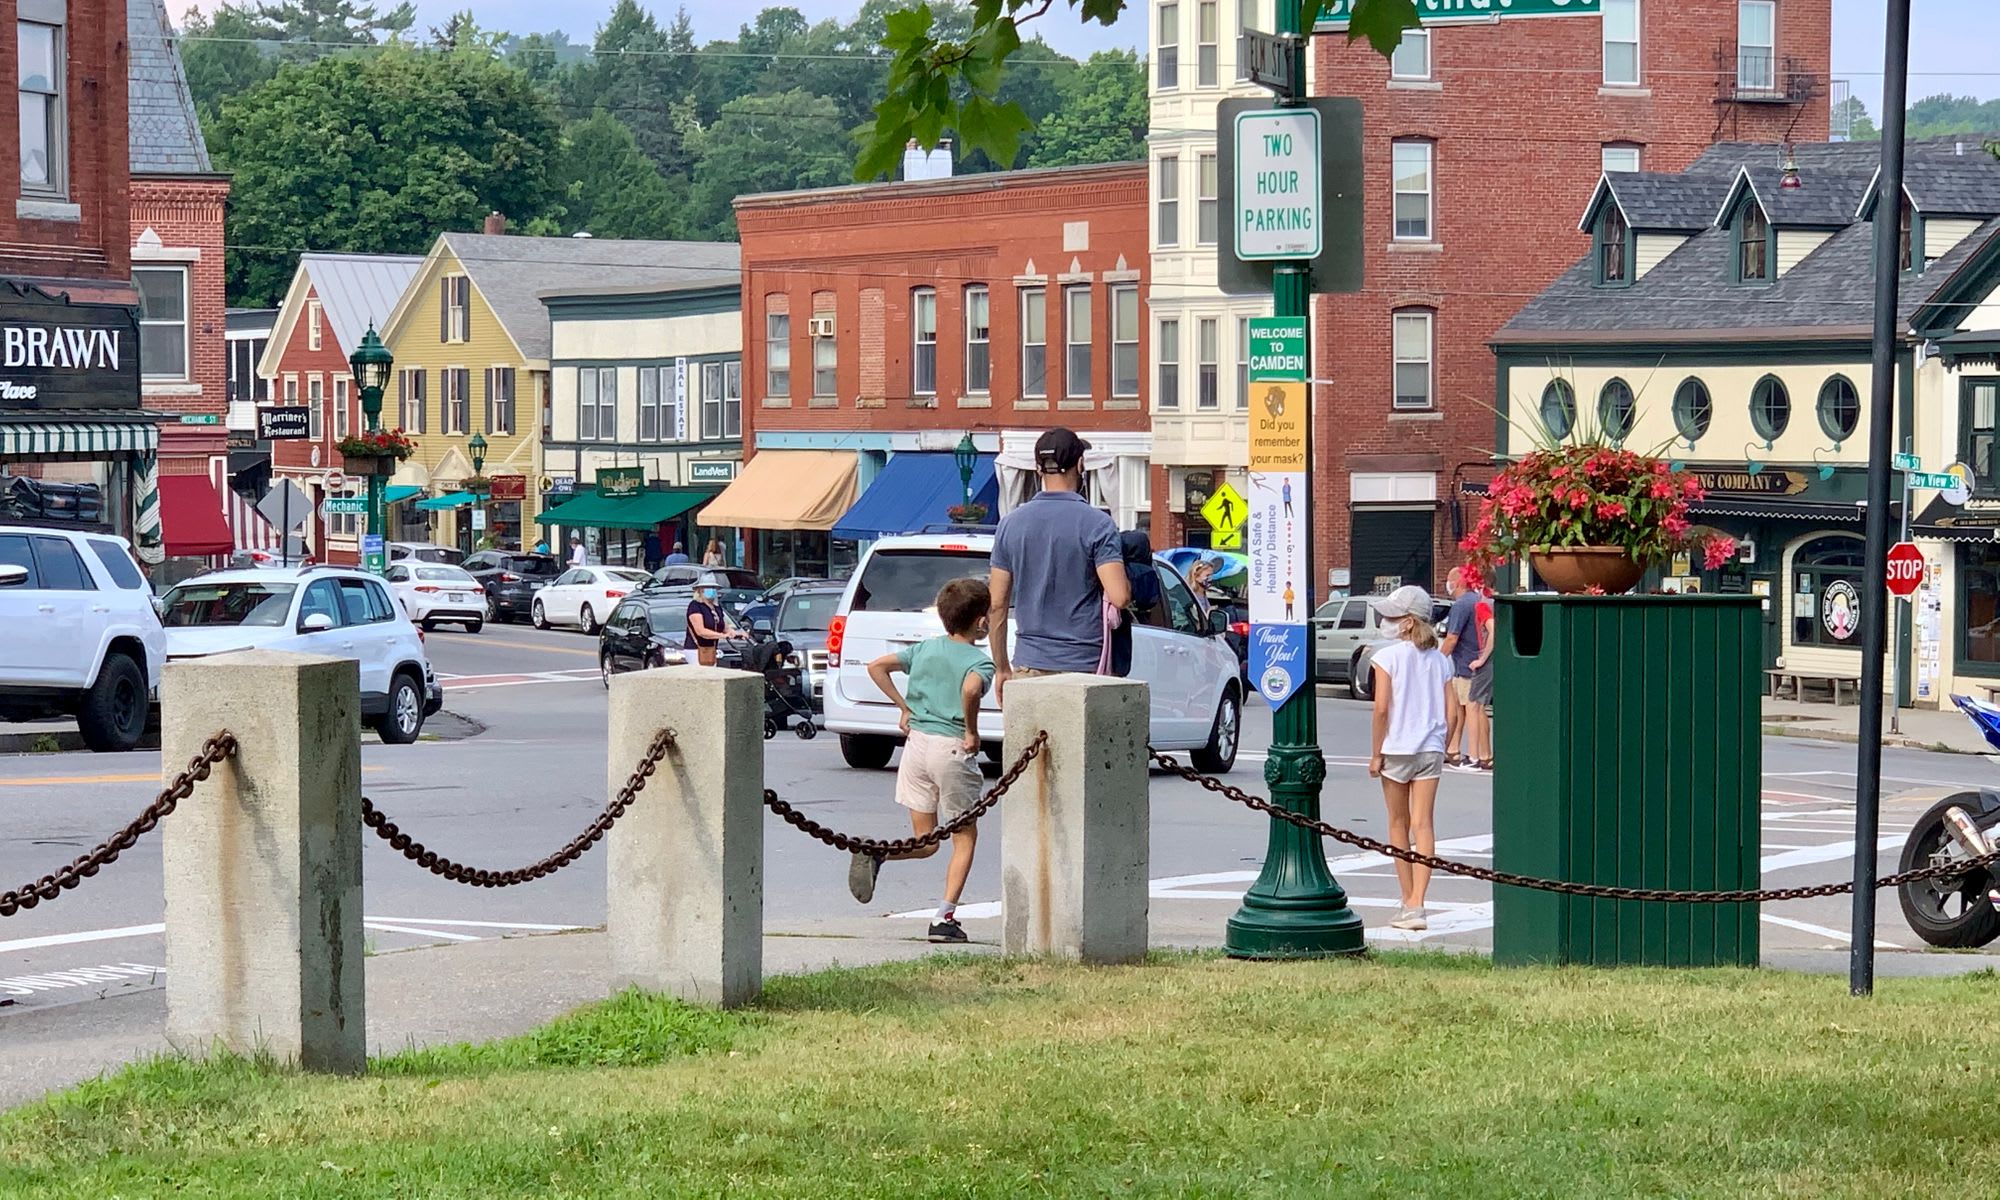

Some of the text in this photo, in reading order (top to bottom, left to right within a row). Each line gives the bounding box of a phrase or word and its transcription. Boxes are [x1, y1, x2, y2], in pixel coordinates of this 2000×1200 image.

[1250, 36, 1282, 78] ELM ST
[1263, 133, 1293, 157] TWO
[1257, 170, 1299, 194] HOUR
[1245, 207, 1312, 232] PARKING
[1250, 328, 1303, 339] WELCOME
[3, 326, 120, 371] BRAWN
[1269, 342, 1284, 353] TO
[1250, 356, 1304, 371] CAMDEN
[261, 411, 307, 426] Marriner's
[1260, 418, 1295, 433] Did you
[263, 425, 306, 437] Restaurant
[1254, 436, 1301, 447] remember
[1250, 453, 1304, 467] your mask?
[694, 466, 729, 477] LandVest
[1717, 473, 1772, 490] COMPANY
[1910, 474, 1959, 488] Bay View St
[325, 500, 364, 512] Mechanic
[1252, 512, 1264, 586] Keep A Safe &
[1266, 504, 1279, 594] Healthy Distance
[1887, 559, 1923, 580] STOP
[1256, 626, 1289, 647] Thank
[1265, 644, 1299, 669] You!
